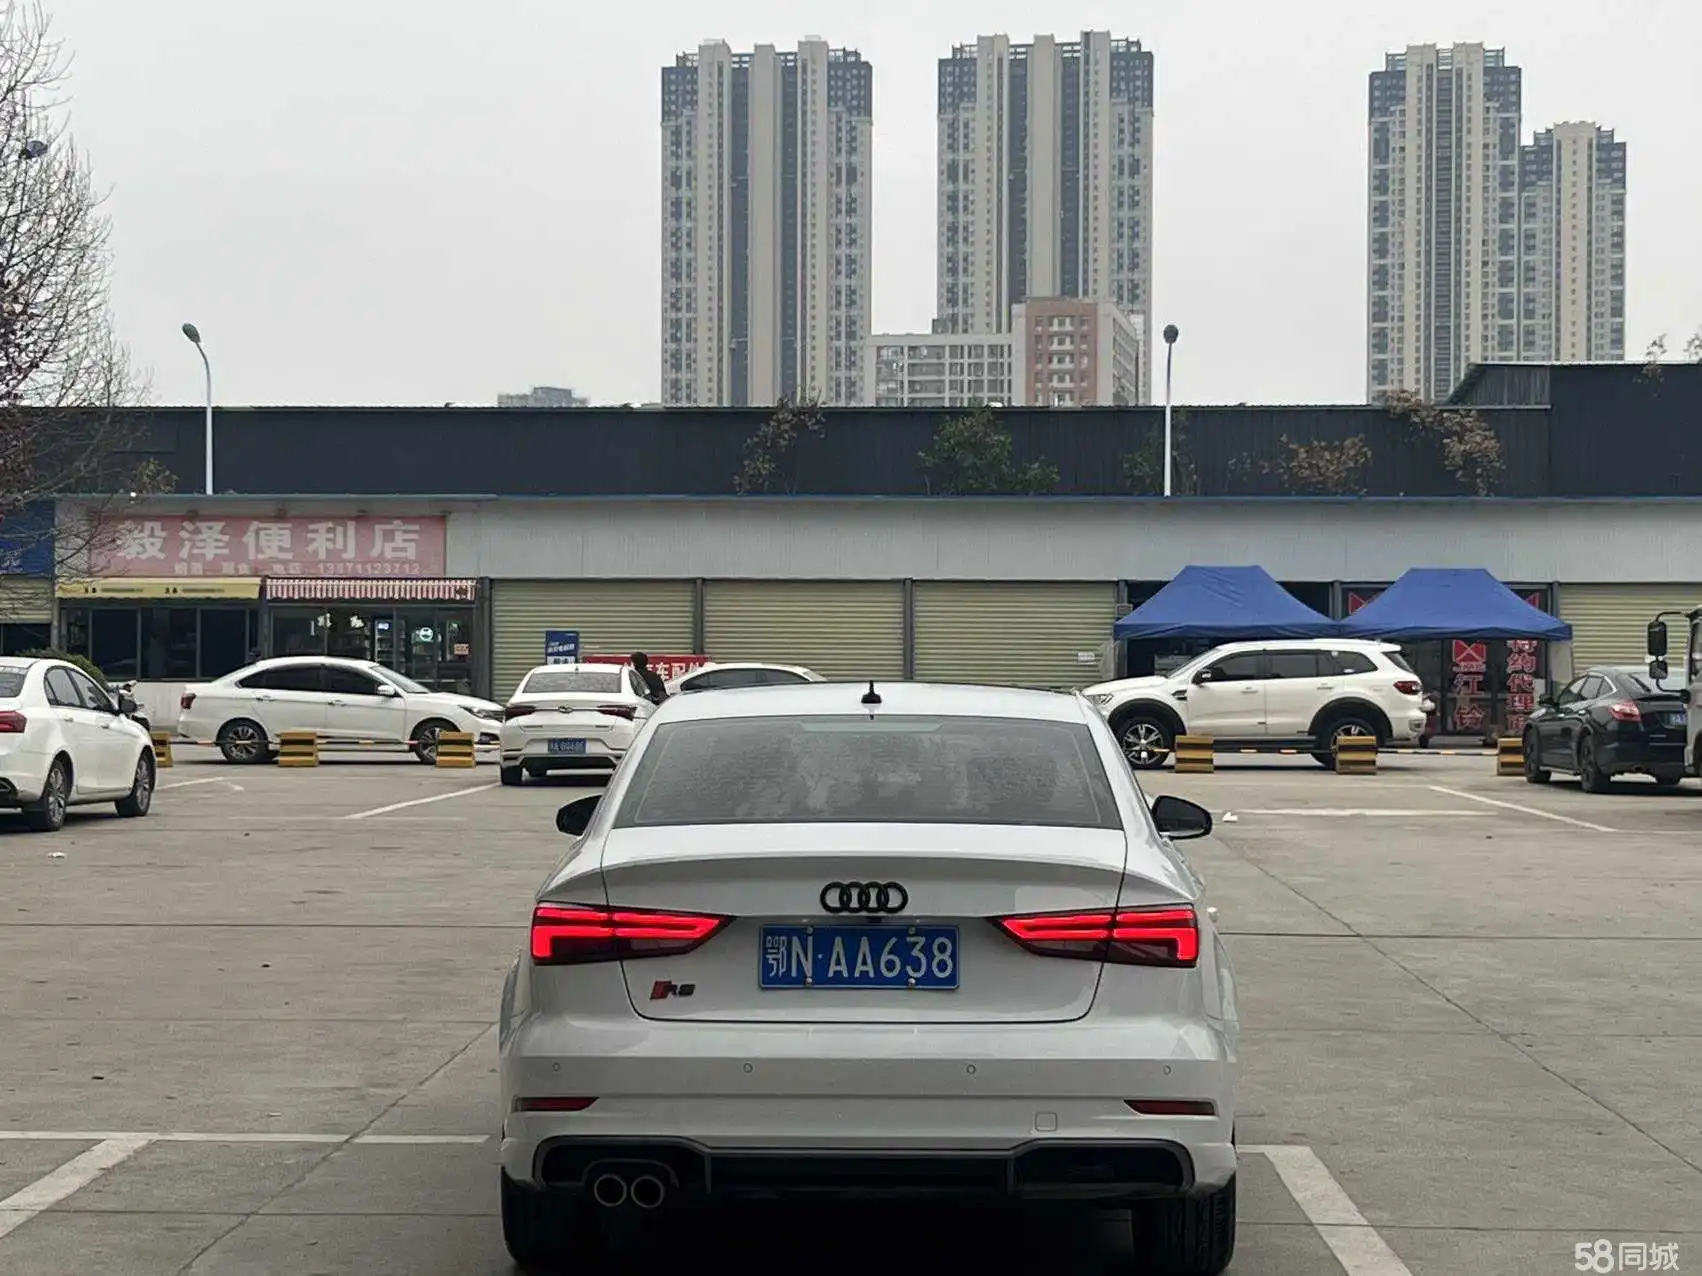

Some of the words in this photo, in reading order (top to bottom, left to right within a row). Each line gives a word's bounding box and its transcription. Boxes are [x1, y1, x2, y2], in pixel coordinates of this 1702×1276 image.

[117, 520, 420, 561] 毅泽便利店
